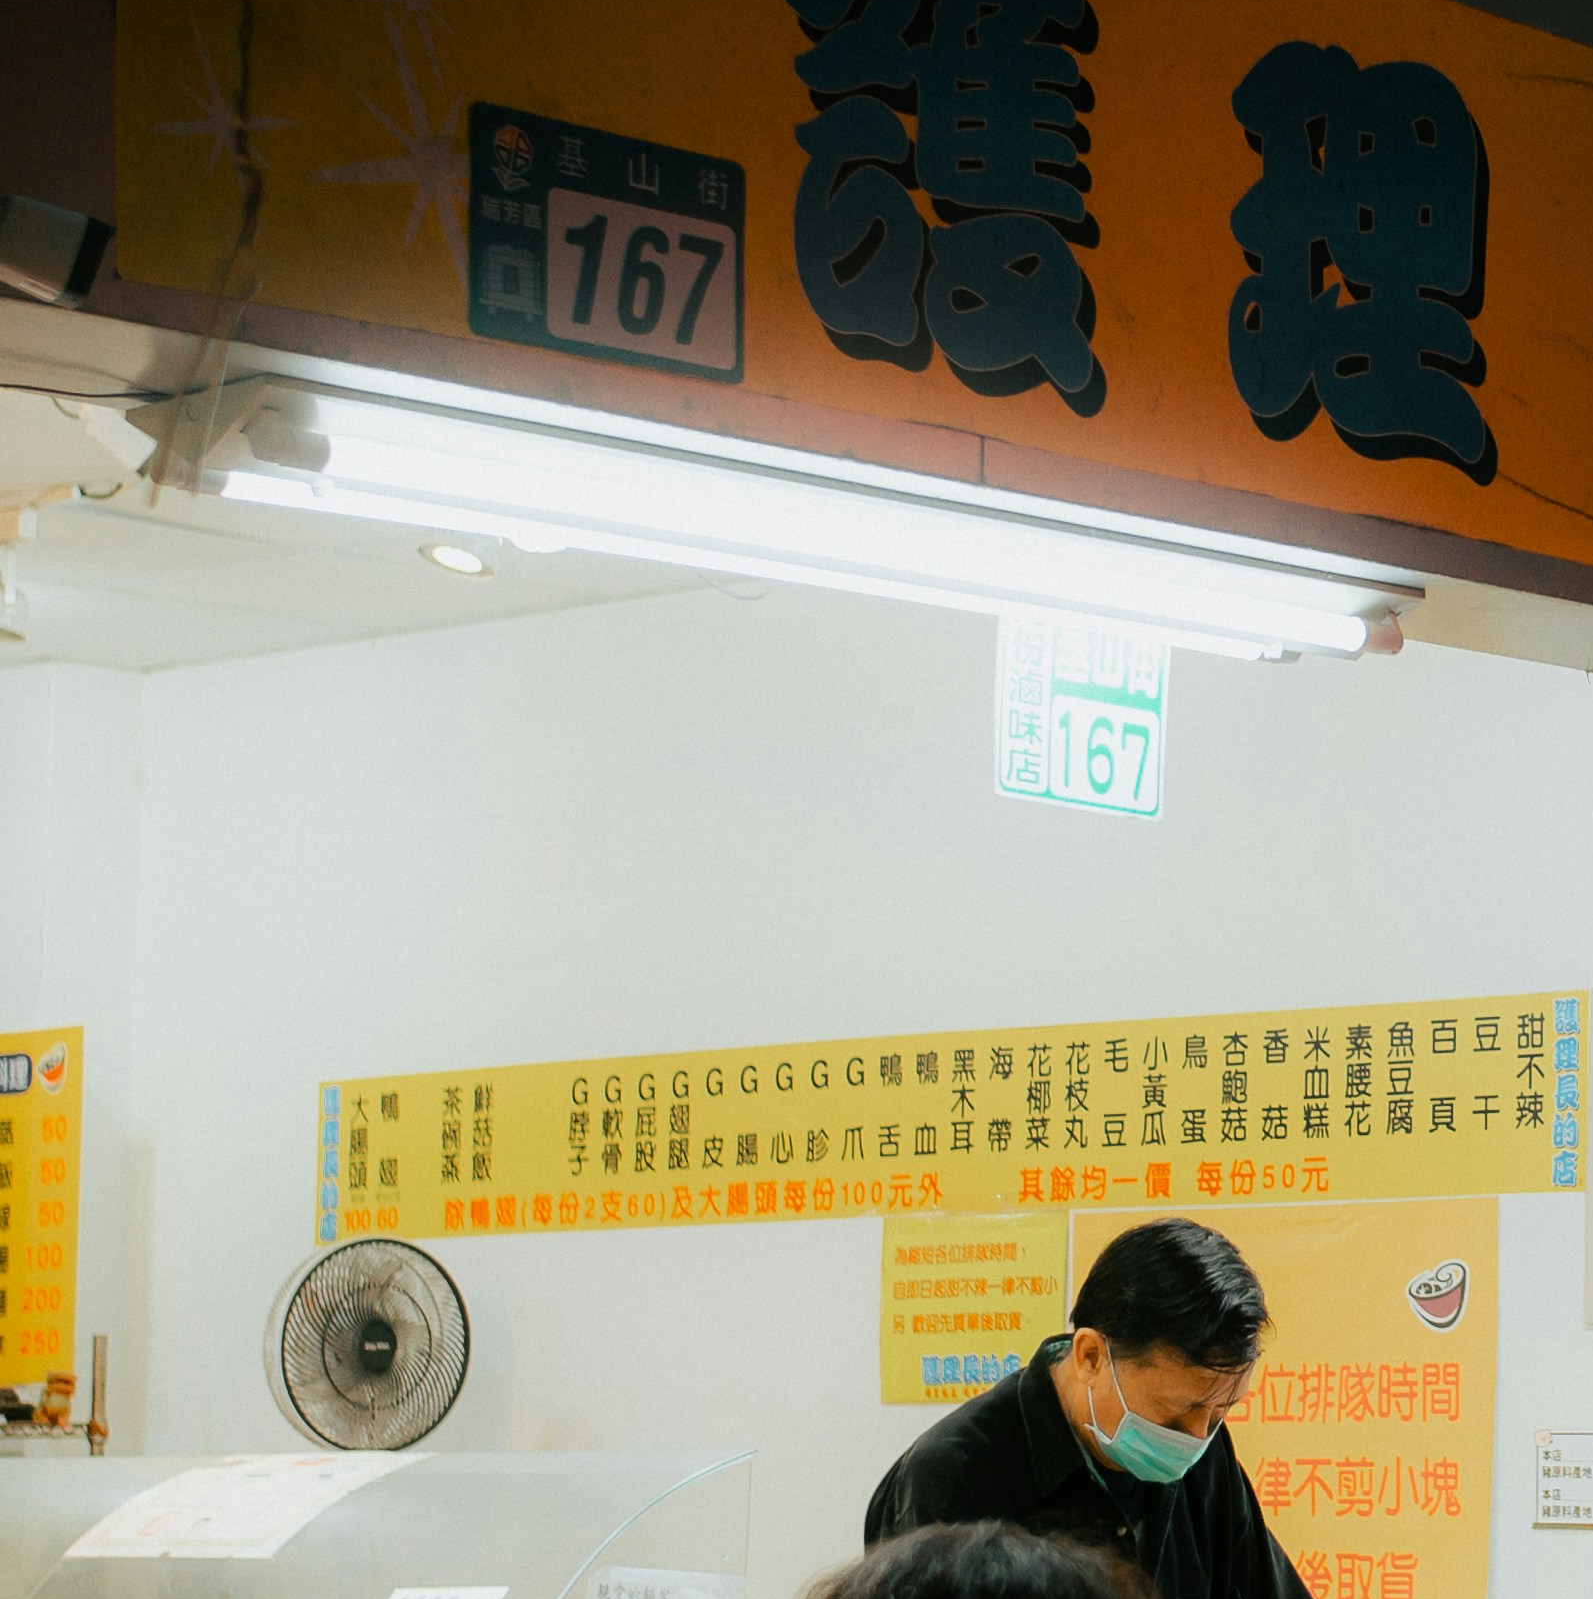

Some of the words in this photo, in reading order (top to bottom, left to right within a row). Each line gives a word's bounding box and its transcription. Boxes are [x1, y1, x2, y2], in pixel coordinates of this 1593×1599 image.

[556, 135, 730, 211] 基山街
[564, 214, 725, 345] 167
[1058, 709, 1151, 802] 167
[702, 1067, 724, 1168] G皮
[736, 1065, 758, 1166] G腸
[770, 1062, 794, 1164] G心
[806, 1060, 829, 1162] G胗
[842, 1057, 864, 1161] G爪
[878, 1052, 902, 1157] 鴨舌
[914, 1050, 939, 1156] 鴨血
[950, 1049, 975, 1154] 黑木耳
[988, 1046, 1013, 1152] 海帶
[1025, 1043, 1052, 1151] 花椰菜
[1064, 1040, 1090, 1149] 花枝丸
[1102, 1038, 1128, 1147] 毛豆
[1141, 1036, 1168, 1146] 小黃瓜
[1180, 1034, 1207, 1144] 鳥蛋
[1221, 1031, 1248, 1143] 杏鮑菇
[1262, 1028, 1288, 1141] 香菇
[1303, 1026, 1330, 1139] 米血糕
[1344, 1023, 1372, 1137] 素腰花
[1386, 1021, 1414, 1135] 魚豆腐
[1429, 1019, 1457, 1133] 百頁
[1472, 1016, 1501, 1130] 豆干
[1516, 1012, 1545, 1129] 甜不辣
[1552, 998, 1580, 1187] 護理長的店
[39, 1156, 66, 1186] 50
[41, 1114, 68, 1143] 50
[602, 1075, 623, 1175] G軟骨
[634, 1073, 656, 1172] G屁股
[38, 1199, 65, 1228] 50
[344, 1206, 371, 1231] 100
[376, 1206, 399, 1231] 60
[1018, 1161, 1172, 1203] 其餘均一價
[1195, 1156, 1329, 1197] 每份50元
[21, 1284, 62, 1313] 200
[26, 1243, 63, 1272] 100
[18, 1329, 60, 1356] 250
[1254, 1455, 1462, 1518] 律不剪小塊
[1542, 1449, 1562, 1462] 本店
[1542, 1488, 1562, 1501] 本店
